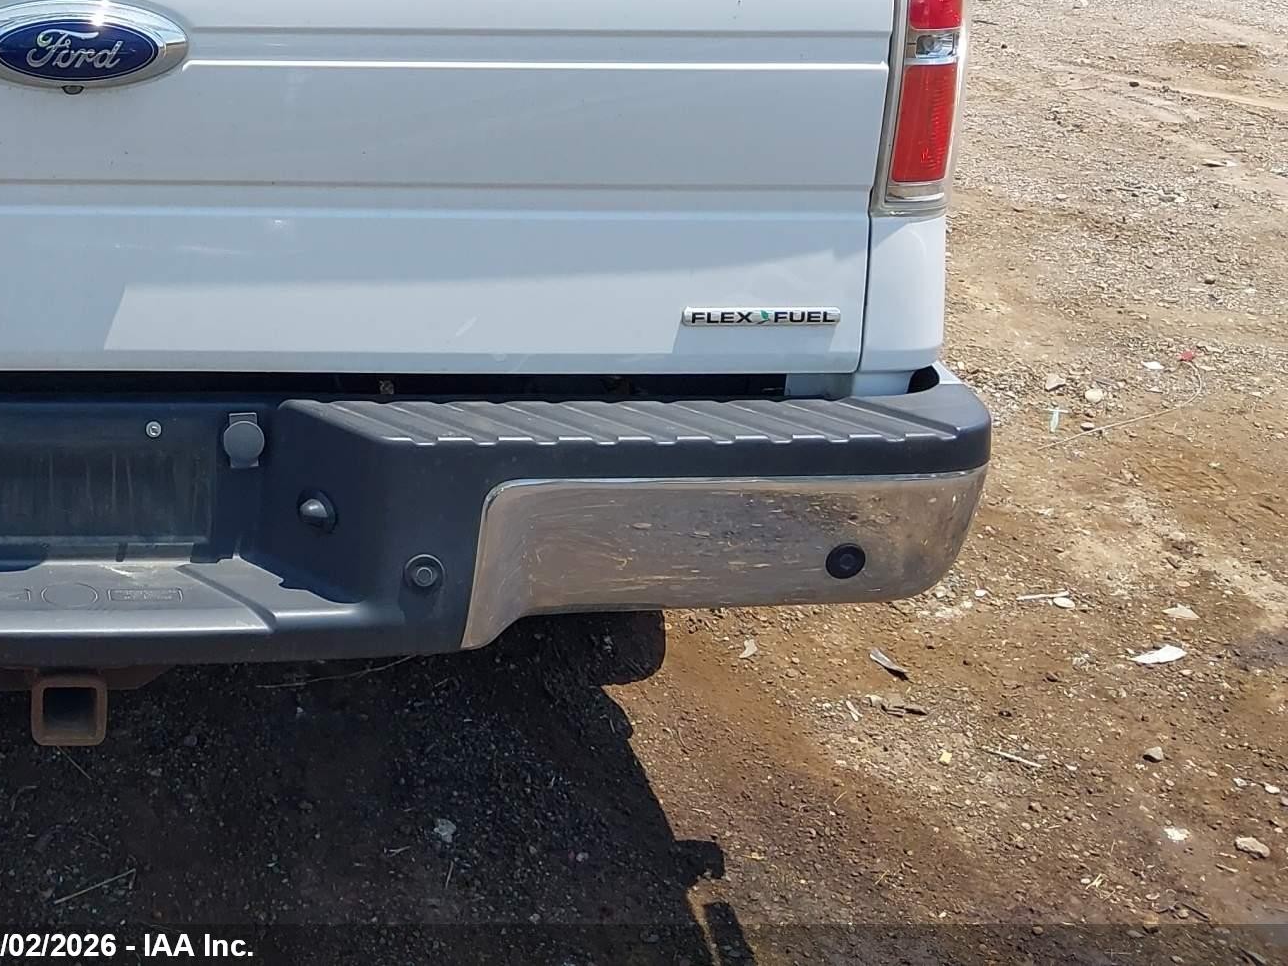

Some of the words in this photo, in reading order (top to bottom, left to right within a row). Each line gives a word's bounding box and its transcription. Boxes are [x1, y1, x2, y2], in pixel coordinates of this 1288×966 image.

[26, 28, 124, 69] Ford
[691, 311, 754, 324] FLEX
[773, 310, 836, 323] FUEL
